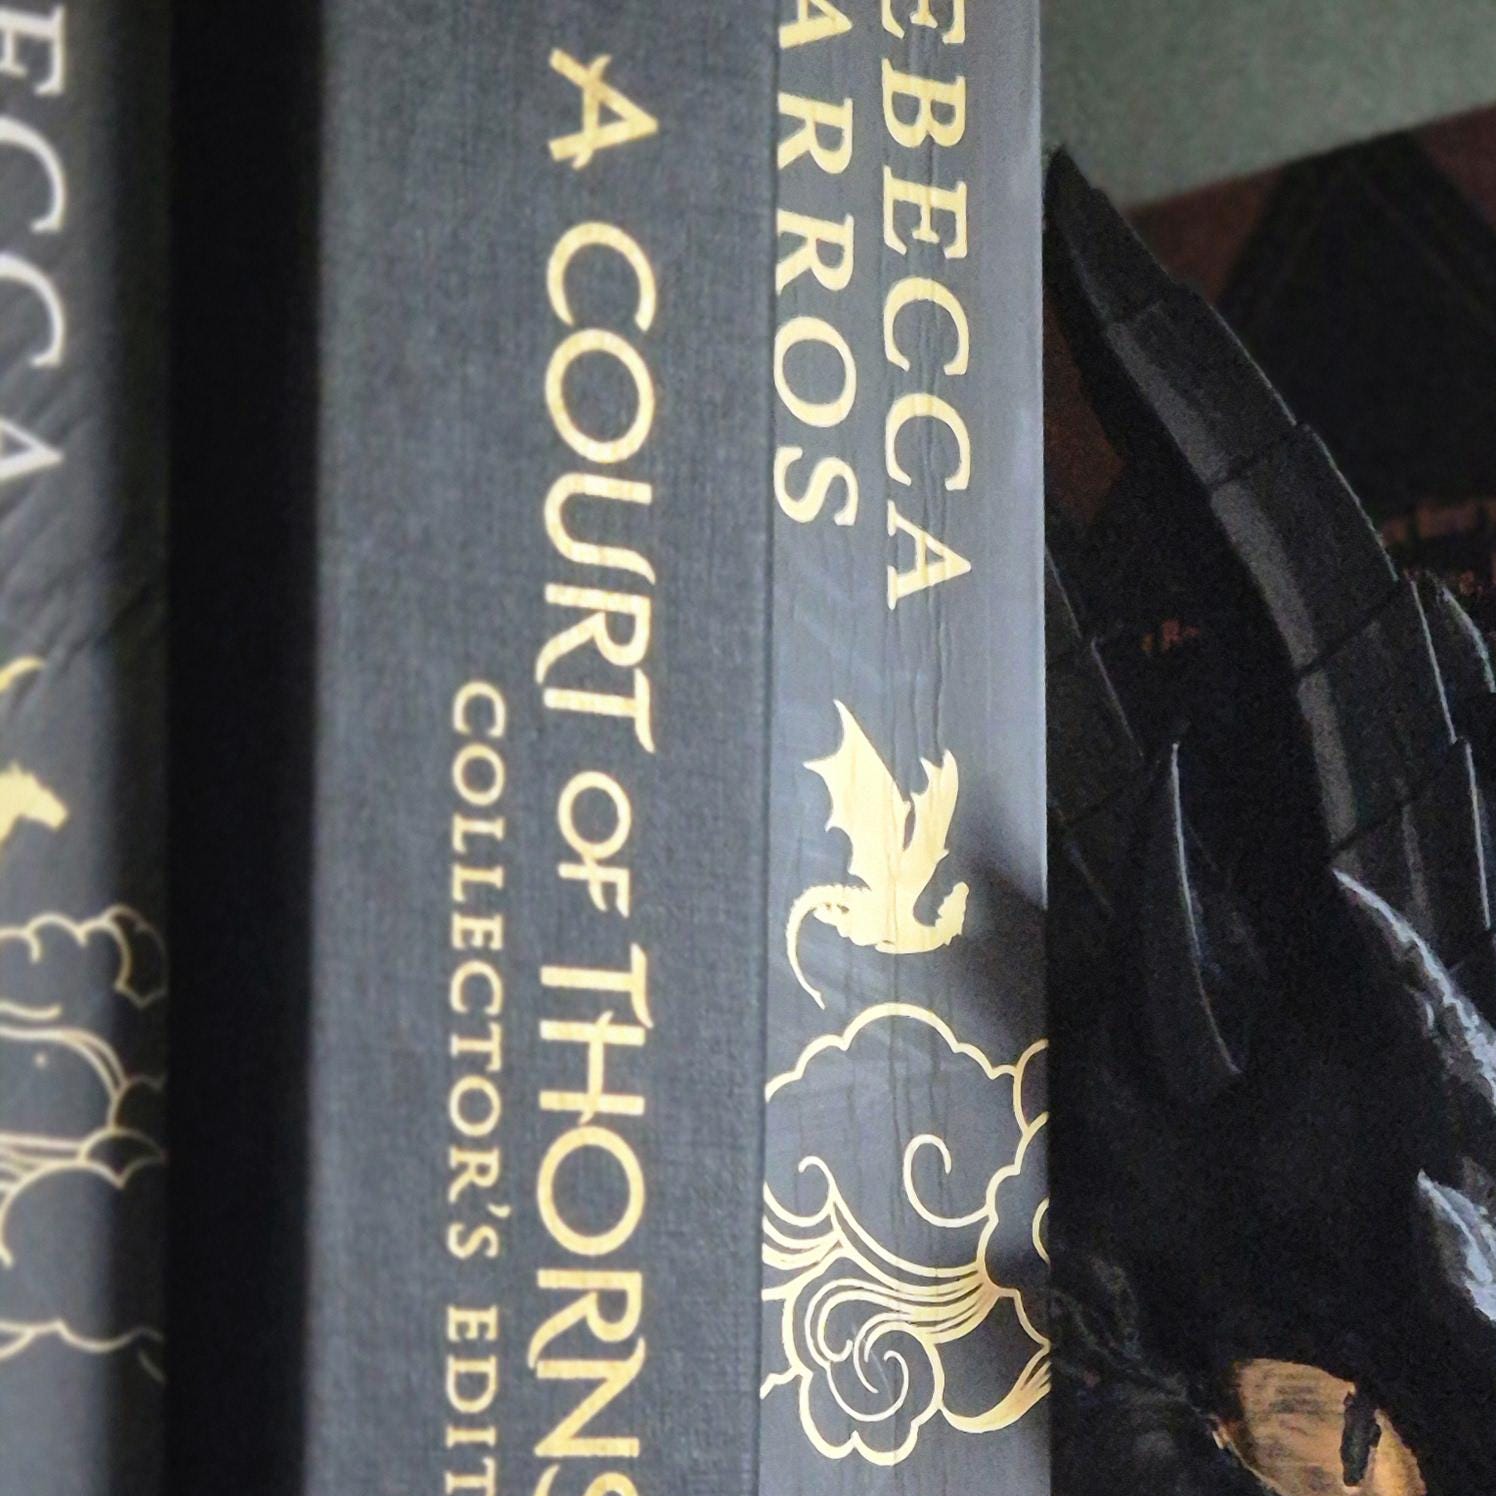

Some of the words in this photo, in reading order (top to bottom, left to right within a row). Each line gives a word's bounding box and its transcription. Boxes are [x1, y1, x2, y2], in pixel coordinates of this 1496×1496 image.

[550, 46, 659, 170] A
[534, 221, 657, 754] COURT
[446, 681, 511, 1261] COLLECTOR'S
[557, 770, 632, 919] OF
